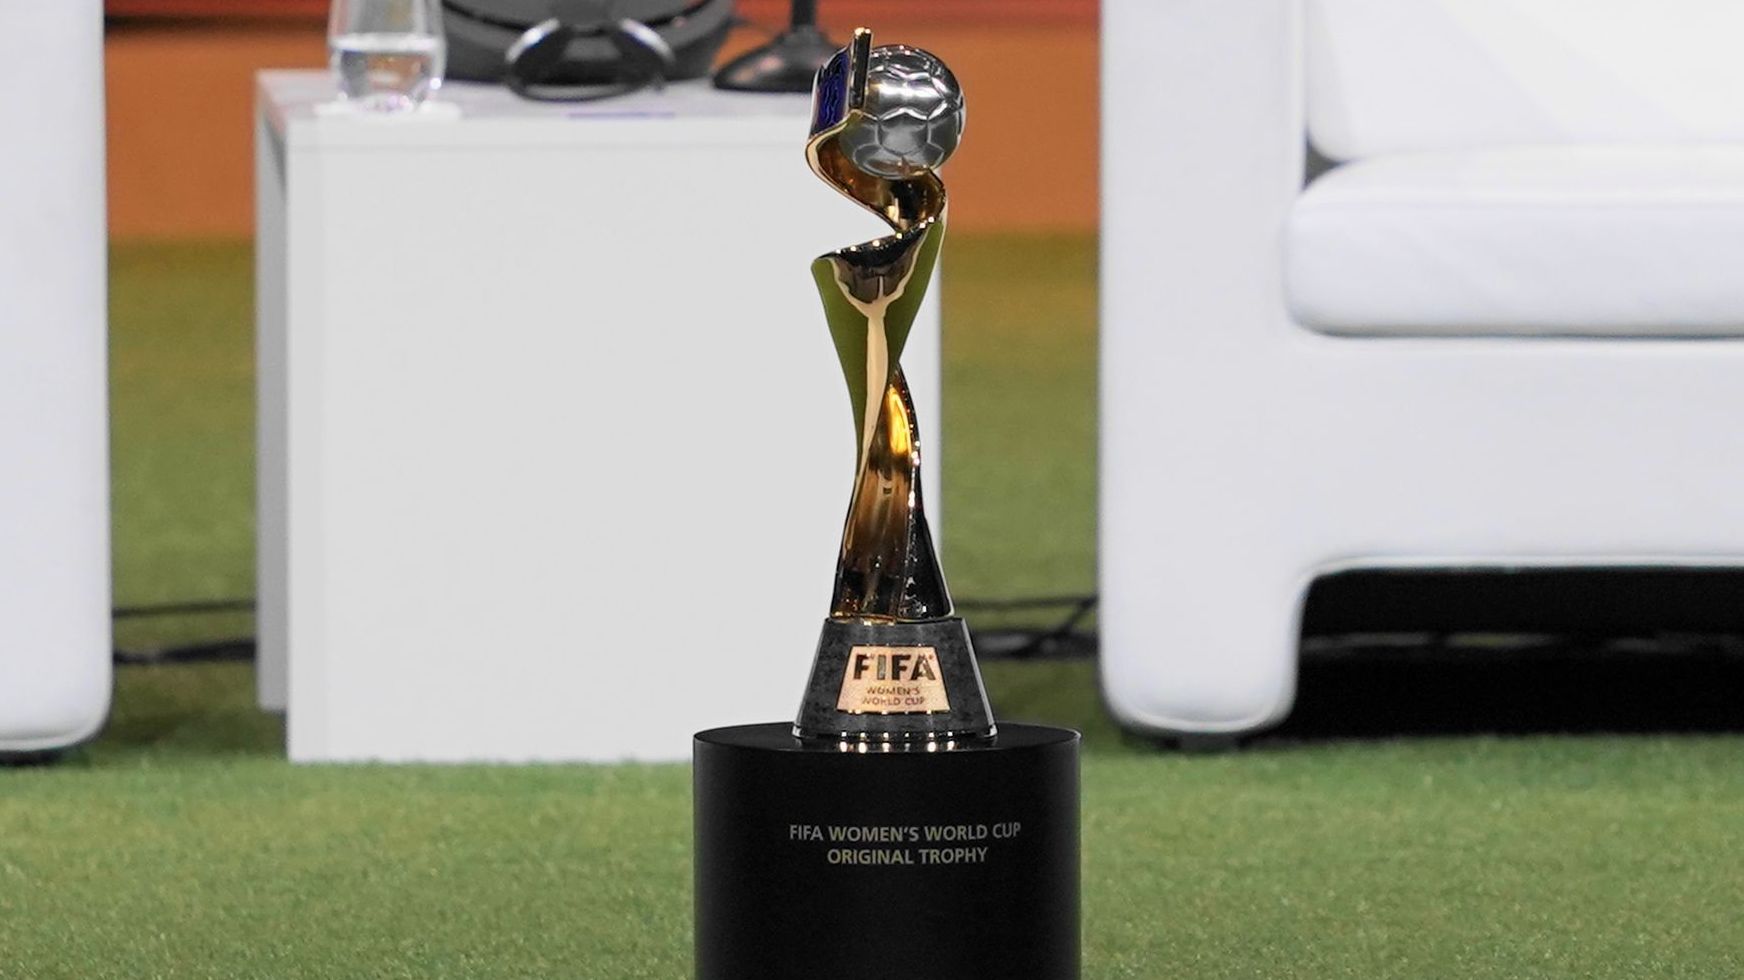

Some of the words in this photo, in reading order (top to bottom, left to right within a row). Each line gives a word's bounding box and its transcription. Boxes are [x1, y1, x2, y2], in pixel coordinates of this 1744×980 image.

[853, 654, 936, 680] FIFA
[867, 686, 920, 695] WOMEN'S
[862, 697, 901, 706] WORLD
[904, 697, 925, 706] CUP
[789, 824, 824, 841] FIFA
[828, 825, 920, 842] WOMEN'S
[924, 824, 988, 841] WORLD
[992, 822, 1021, 839] CUP
[827, 848, 915, 865] ORIGINAL
[918, 847, 988, 865] TROPHY
